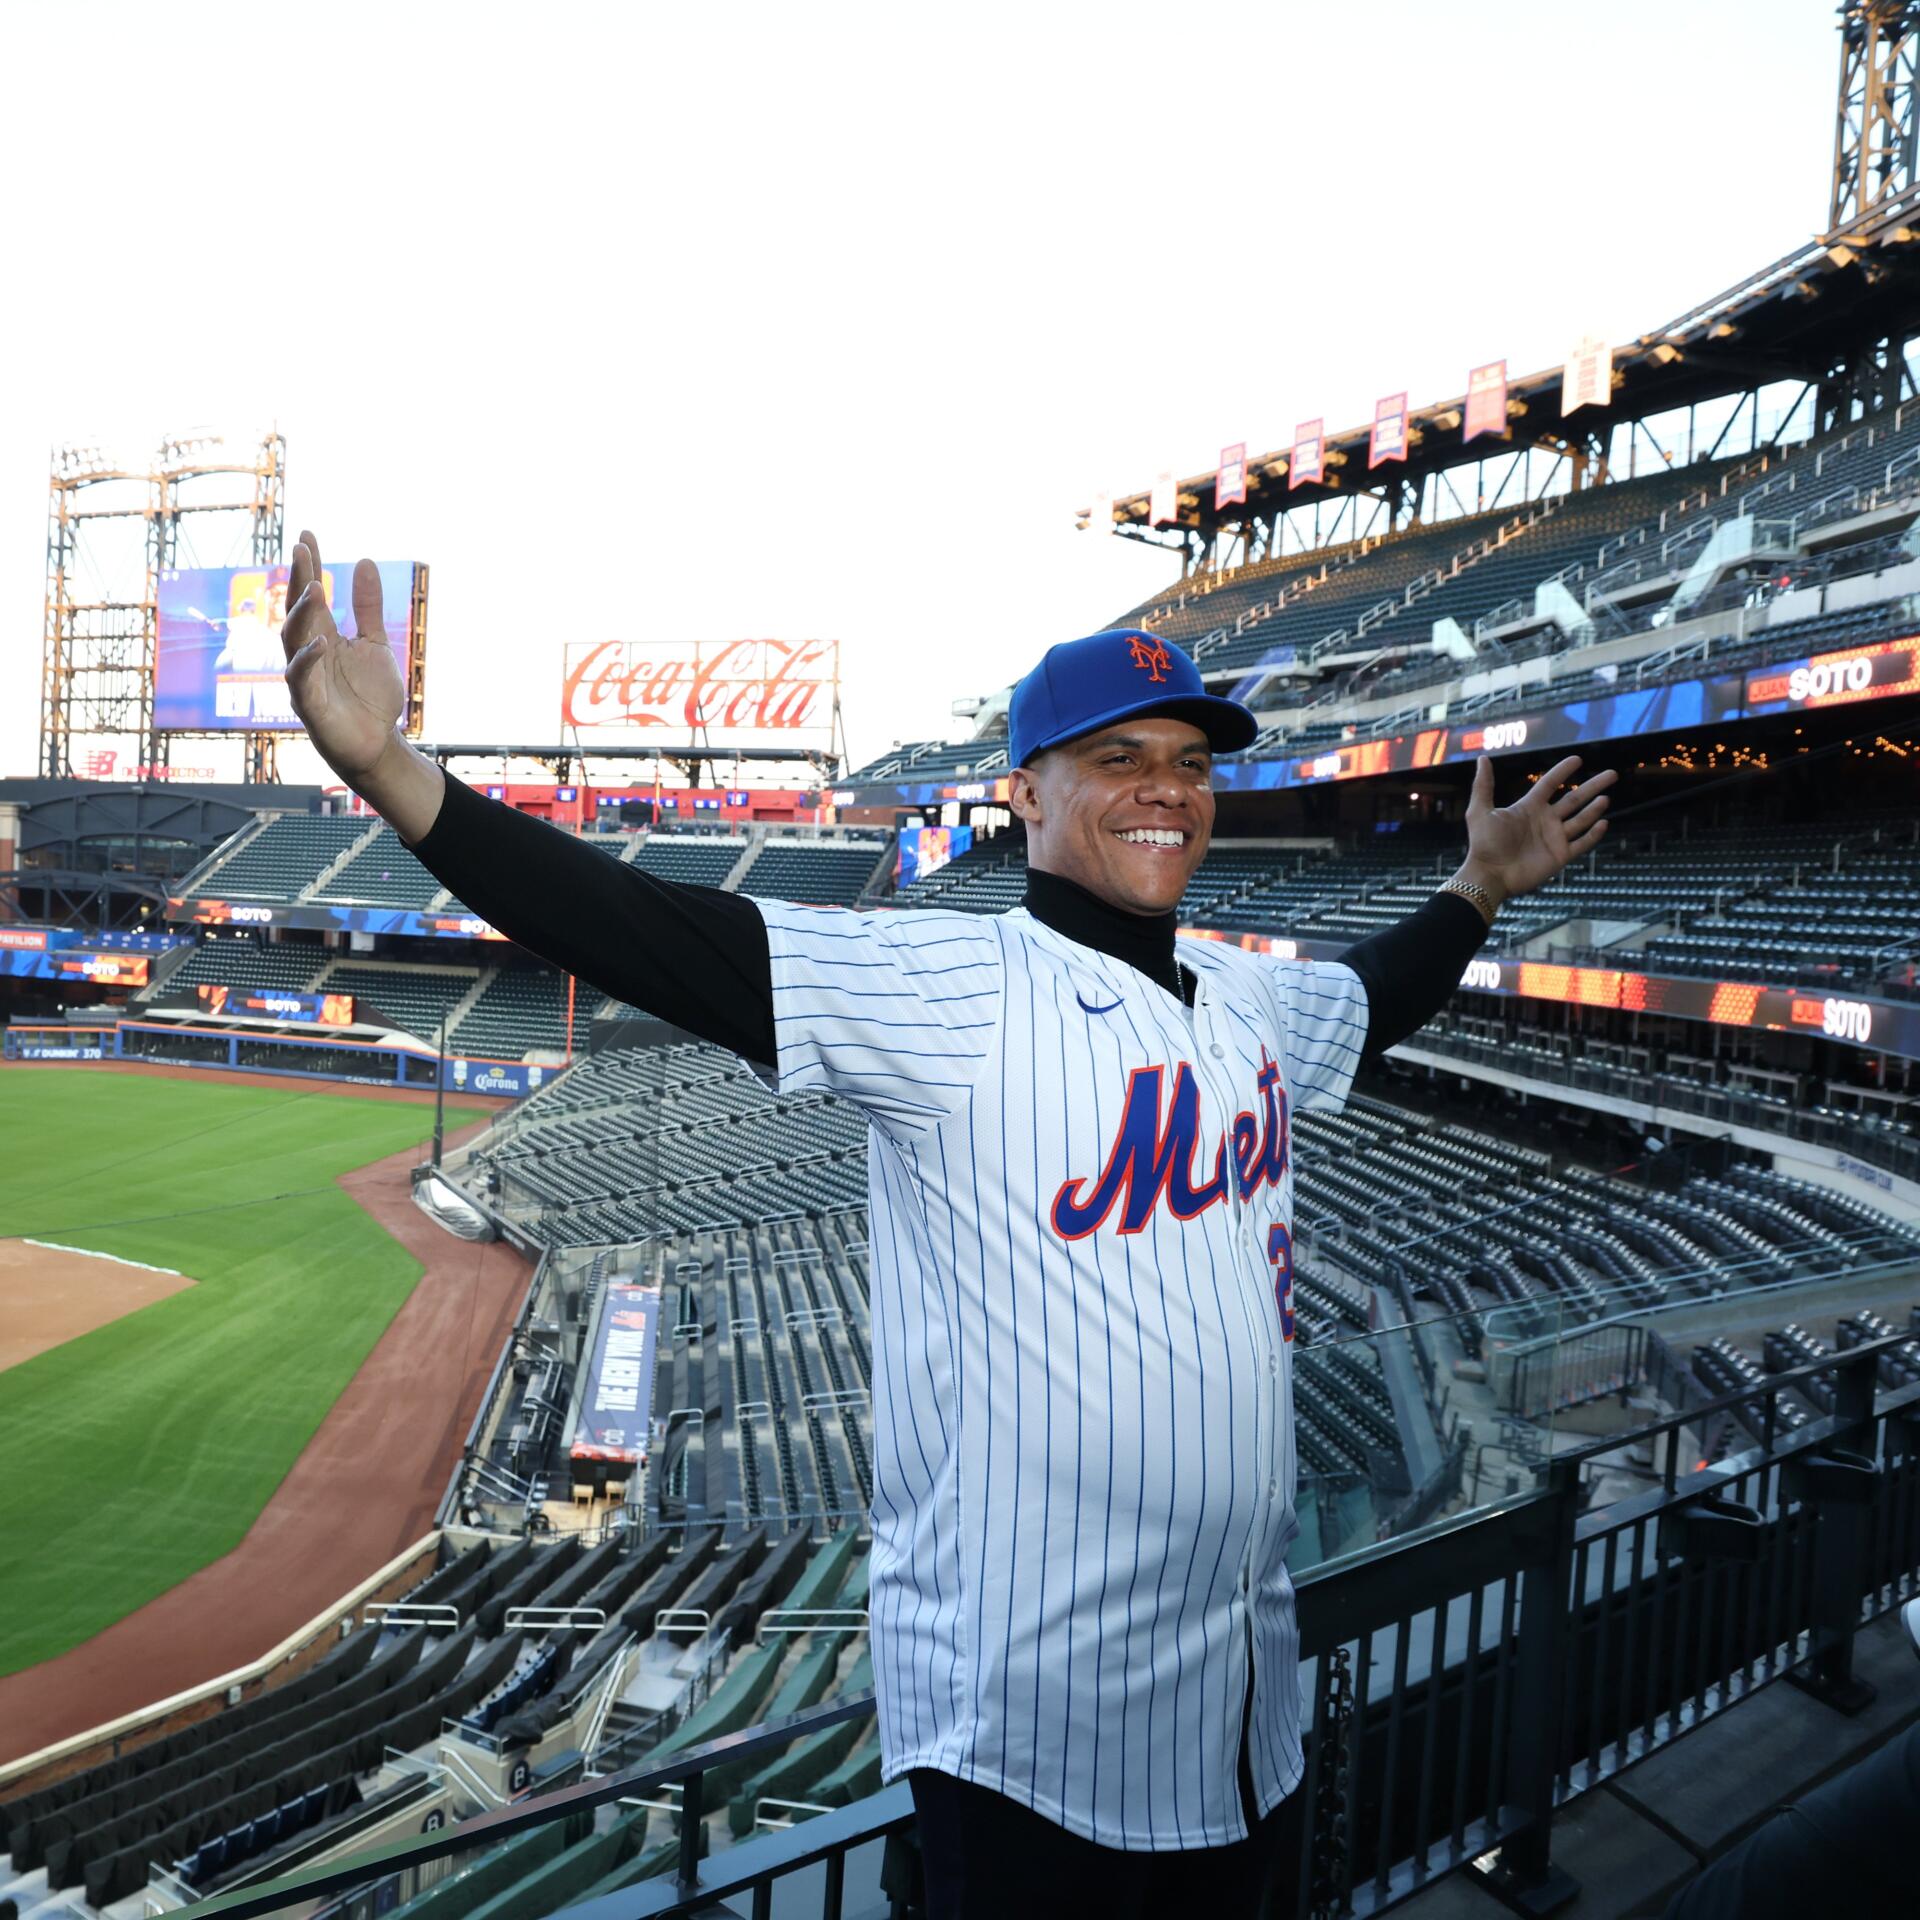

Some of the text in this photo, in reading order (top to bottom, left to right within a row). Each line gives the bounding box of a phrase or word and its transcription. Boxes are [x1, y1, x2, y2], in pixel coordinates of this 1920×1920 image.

[561, 639, 838, 729] Coca-Cola
[1788, 657, 1873, 700] SOTO
[1482, 720, 1528, 750] SOTO
[1313, 755, 1342, 778] SOTO
[956, 784, 985, 799] SOTO
[231, 907, 272, 922] SOTO
[82, 962, 119, 976] SOTO
[1460, 960, 1501, 989] OTO
[265, 998, 301, 1012] SOTO
[1823, 998, 1872, 1042] SOTO
[82, 1048, 101, 1060] 370
[148, 1056, 191, 1068] CADILLAC
[345, 1075, 393, 1087] CADILLAC
[474, 1073, 519, 1092] Corona
[604, 1328, 645, 1358] YORK
[600, 1358, 641, 1388] NEW
[595, 1386, 638, 1411] THE
